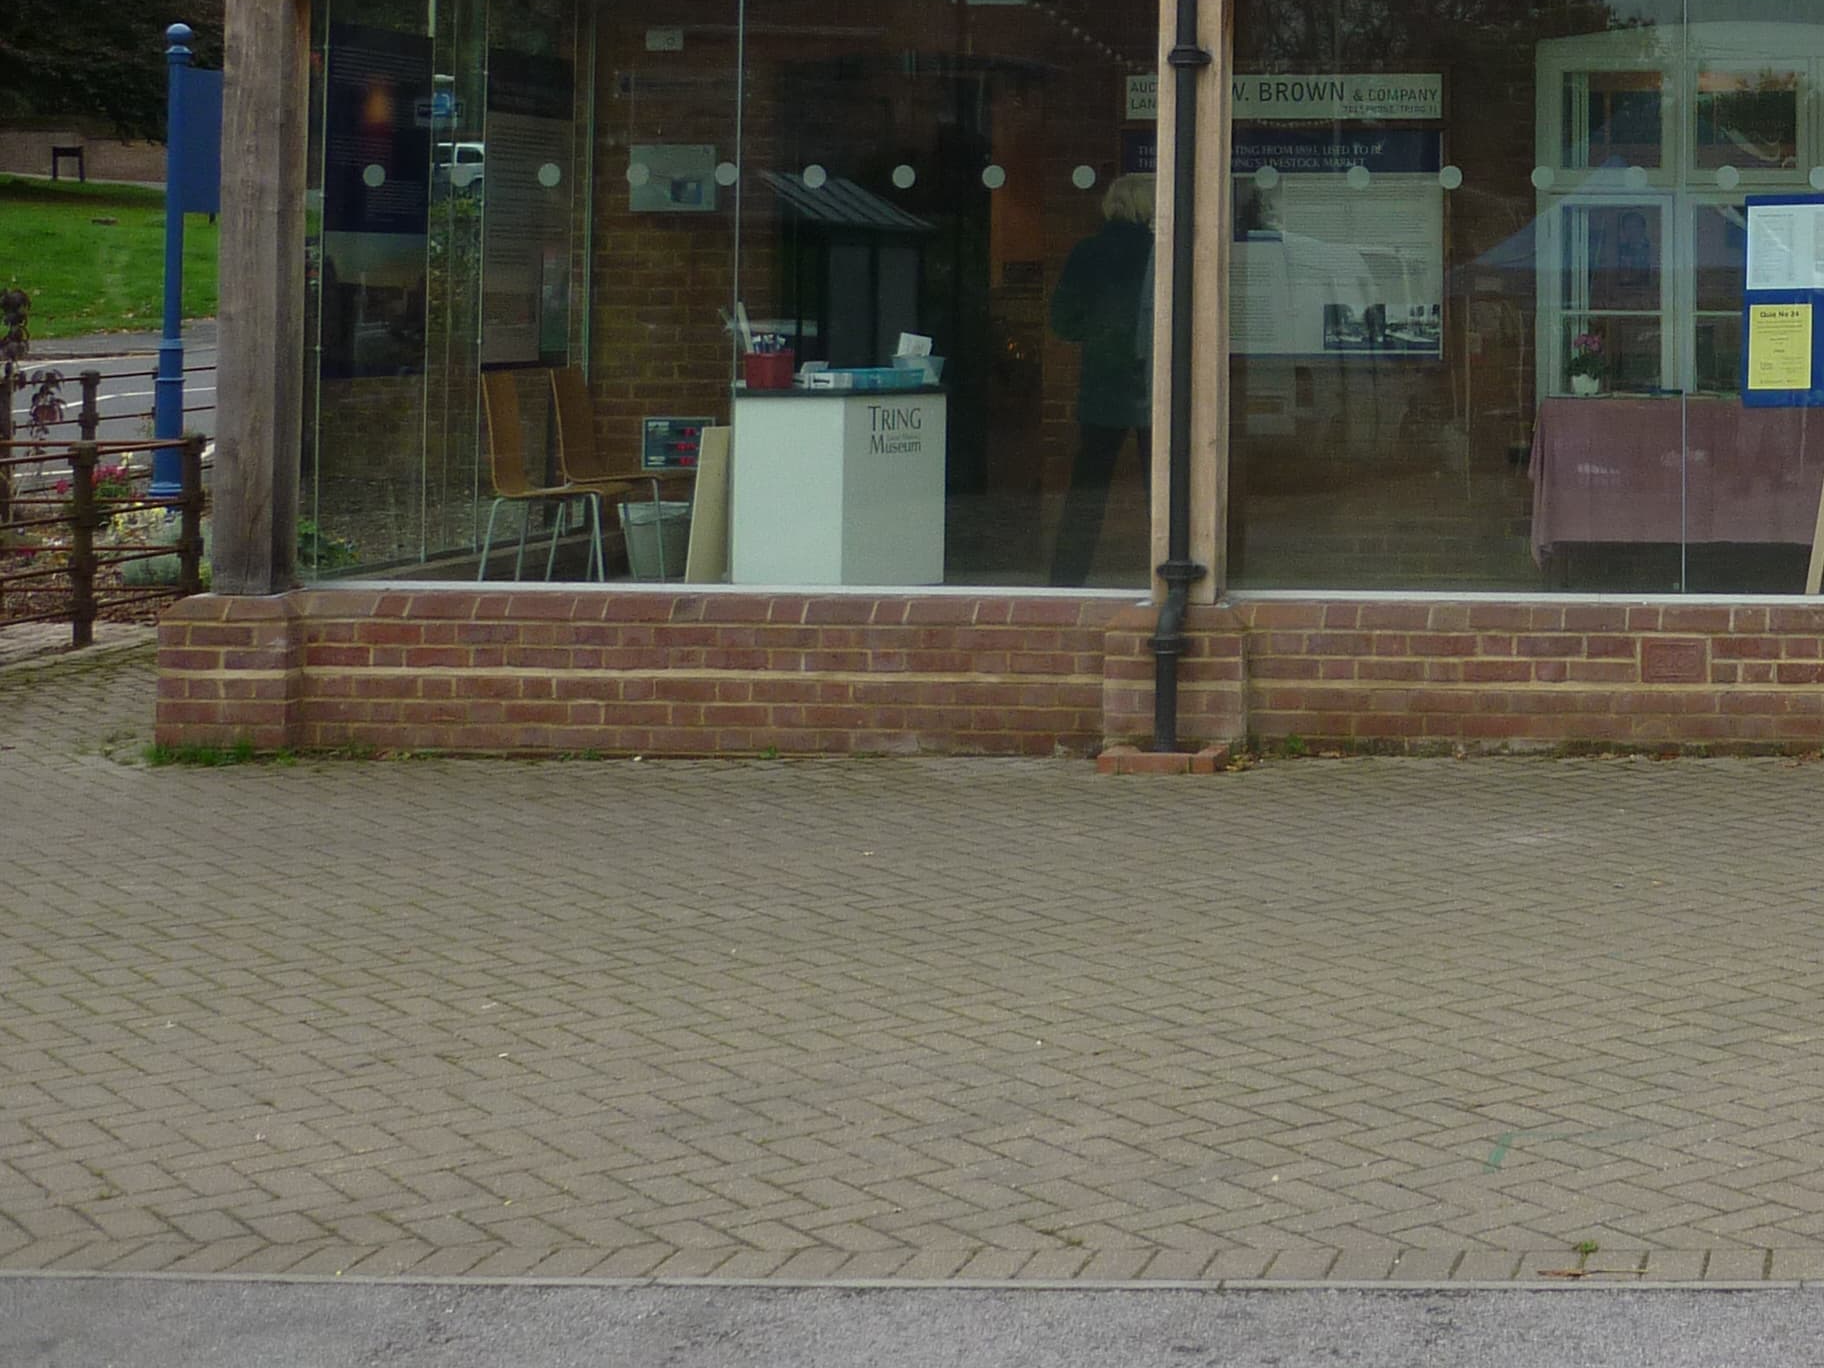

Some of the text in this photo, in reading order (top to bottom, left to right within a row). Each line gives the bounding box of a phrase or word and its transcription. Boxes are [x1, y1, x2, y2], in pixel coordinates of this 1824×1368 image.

[1130, 81, 1156, 93] AUC
[1259, 81, 1344, 102] BROWN
[1352, 88, 1363, 102] &
[1368, 88, 1438, 101] COMPANY
[1131, 98, 1156, 110] LAN
[1263, 145, 1293, 155] FROM
[1352, 143, 1369, 153] TO
[1265, 158, 1320, 168] LIVESTOCK
[1322, 158, 1366, 167] MARKET
[867, 406, 921, 431] TRING
[870, 434, 921, 454] Museum
